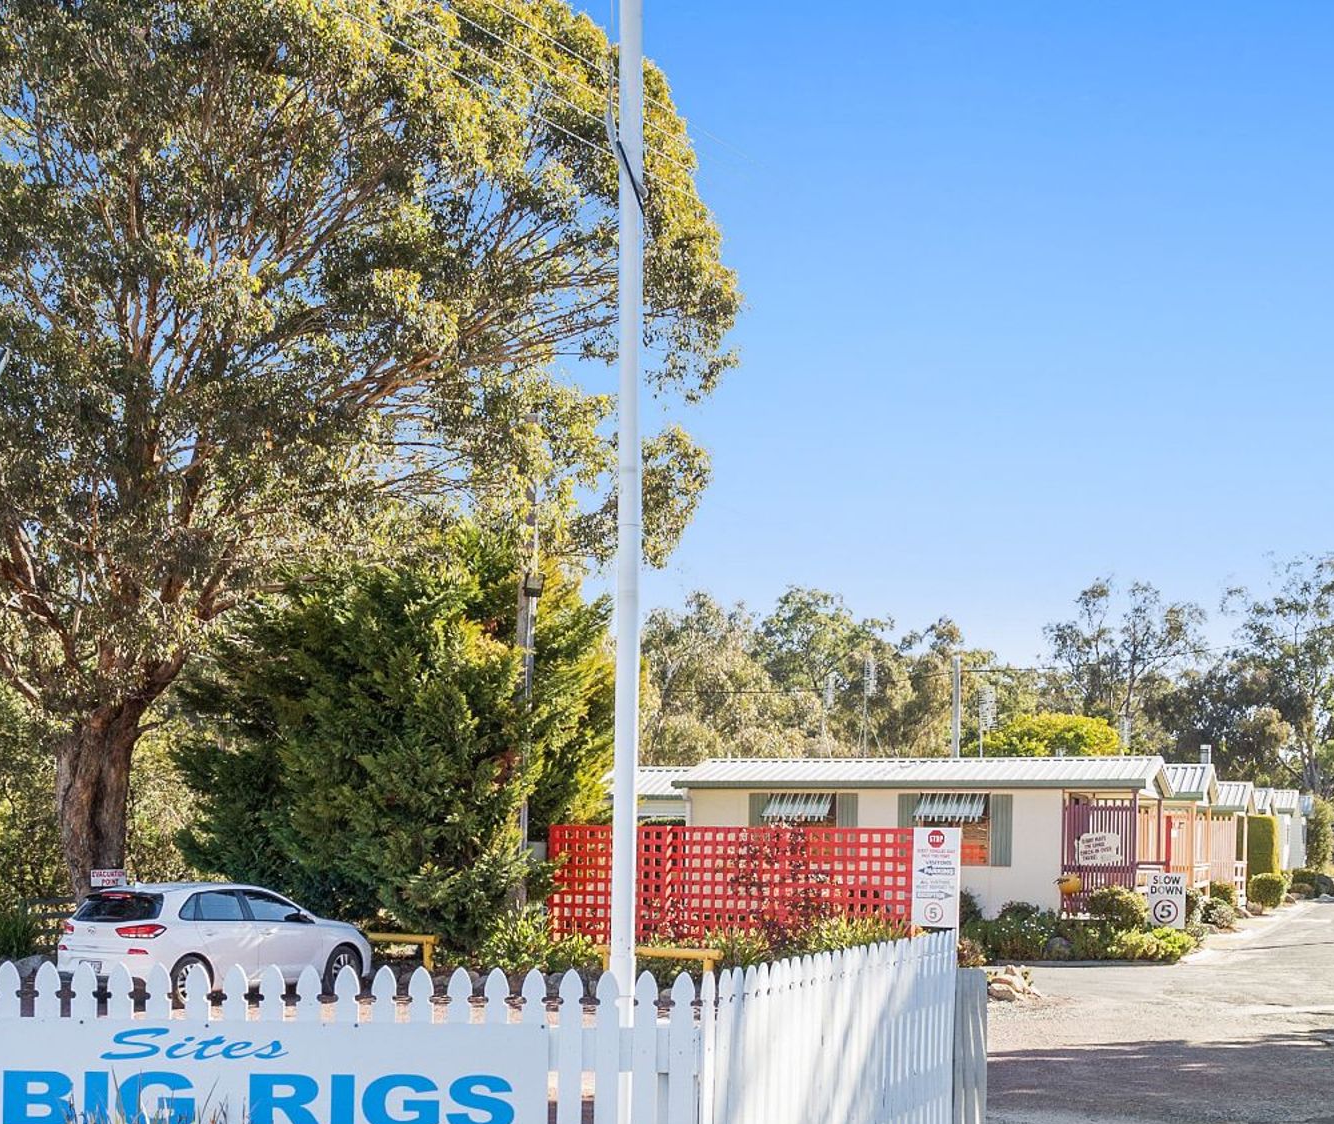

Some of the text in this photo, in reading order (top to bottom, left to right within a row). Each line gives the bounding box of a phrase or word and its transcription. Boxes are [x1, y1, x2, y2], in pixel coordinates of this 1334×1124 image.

[930, 835, 944, 843] STOP
[1153, 875, 1181, 885] SLOW
[1150, 885, 1183, 895] DOWN
[929, 907, 937, 919] 5
[1160, 904, 1172, 919] 5
[100, 1027, 288, 1061] Sites
